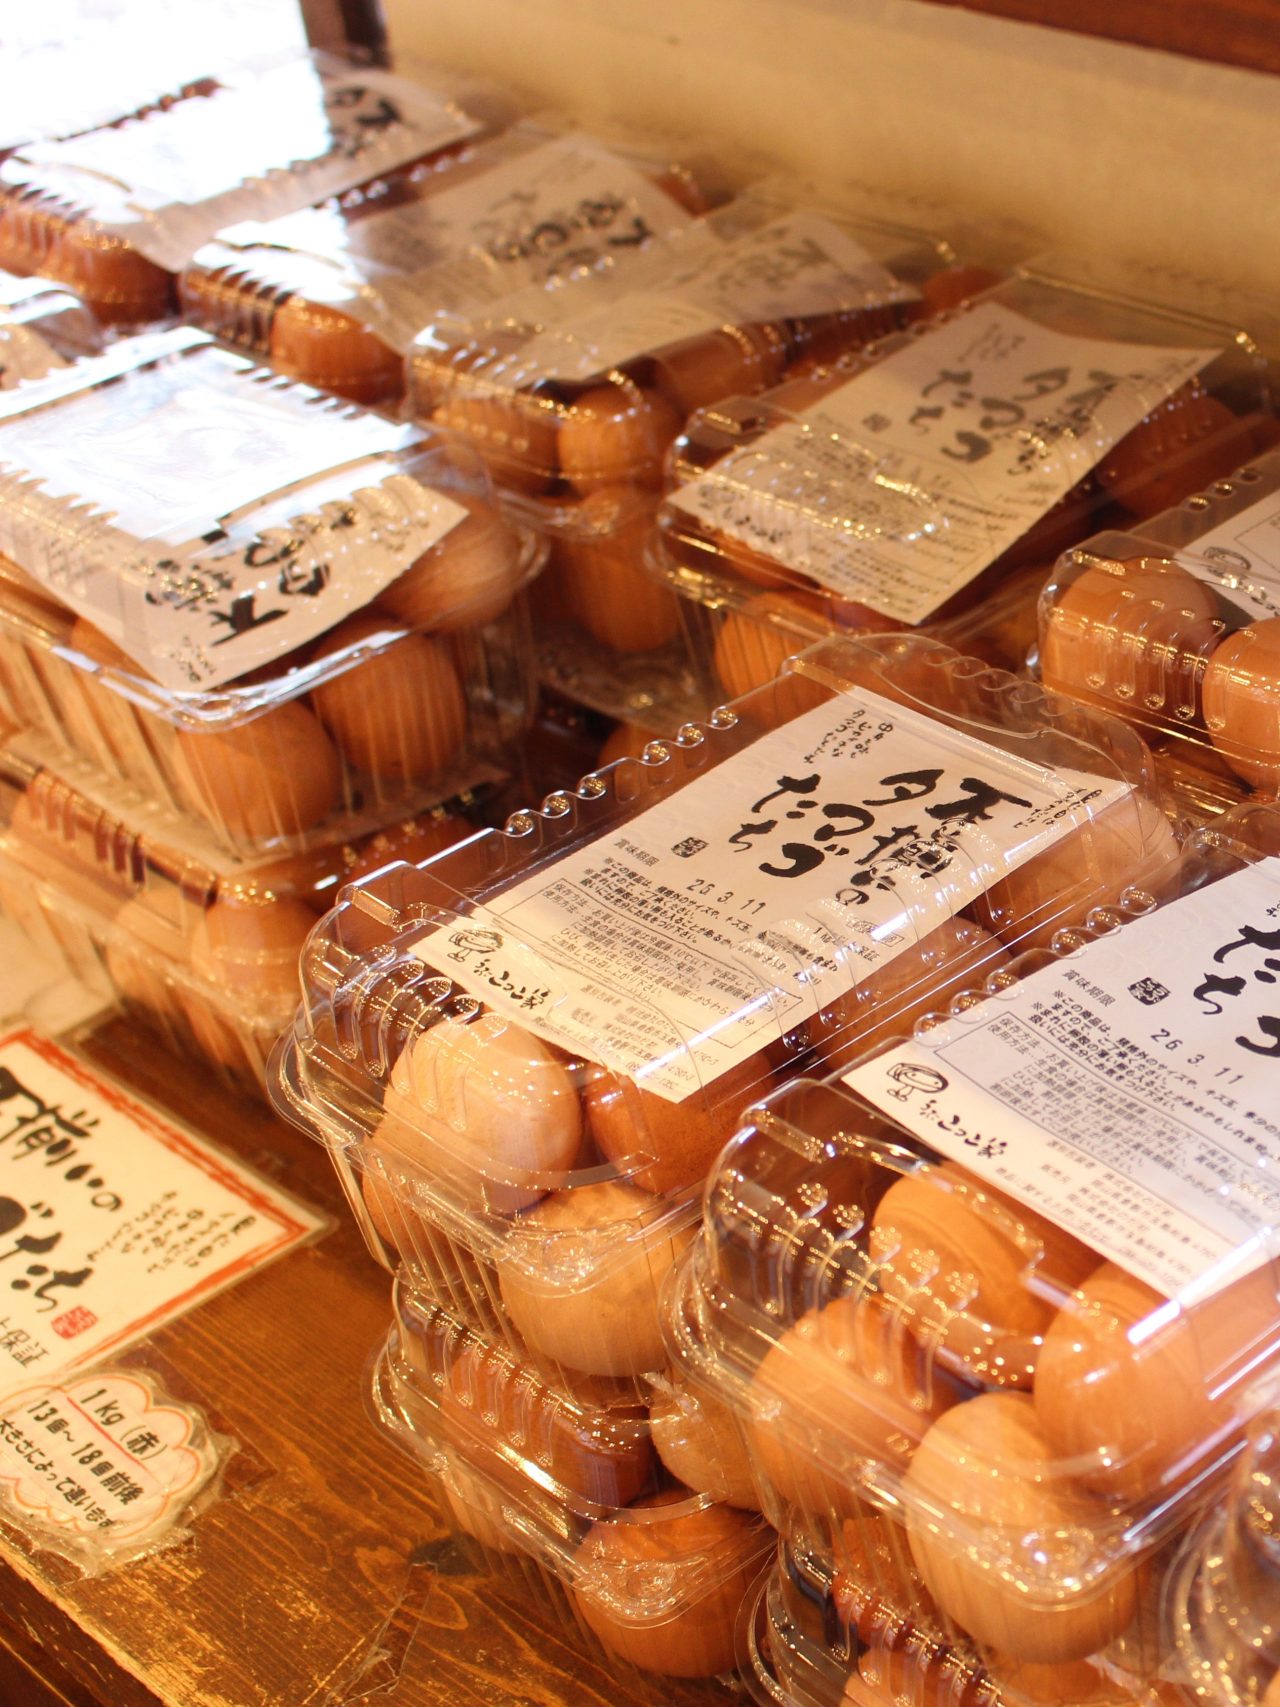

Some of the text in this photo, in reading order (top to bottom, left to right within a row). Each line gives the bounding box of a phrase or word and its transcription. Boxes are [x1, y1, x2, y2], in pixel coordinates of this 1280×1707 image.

[730, 774, 821, 853] たち
[758, 769, 945, 878] タマゴ
[613, 838, 660, 867] 賞味期限
[1061, 969, 1116, 1008] 賞味期限
